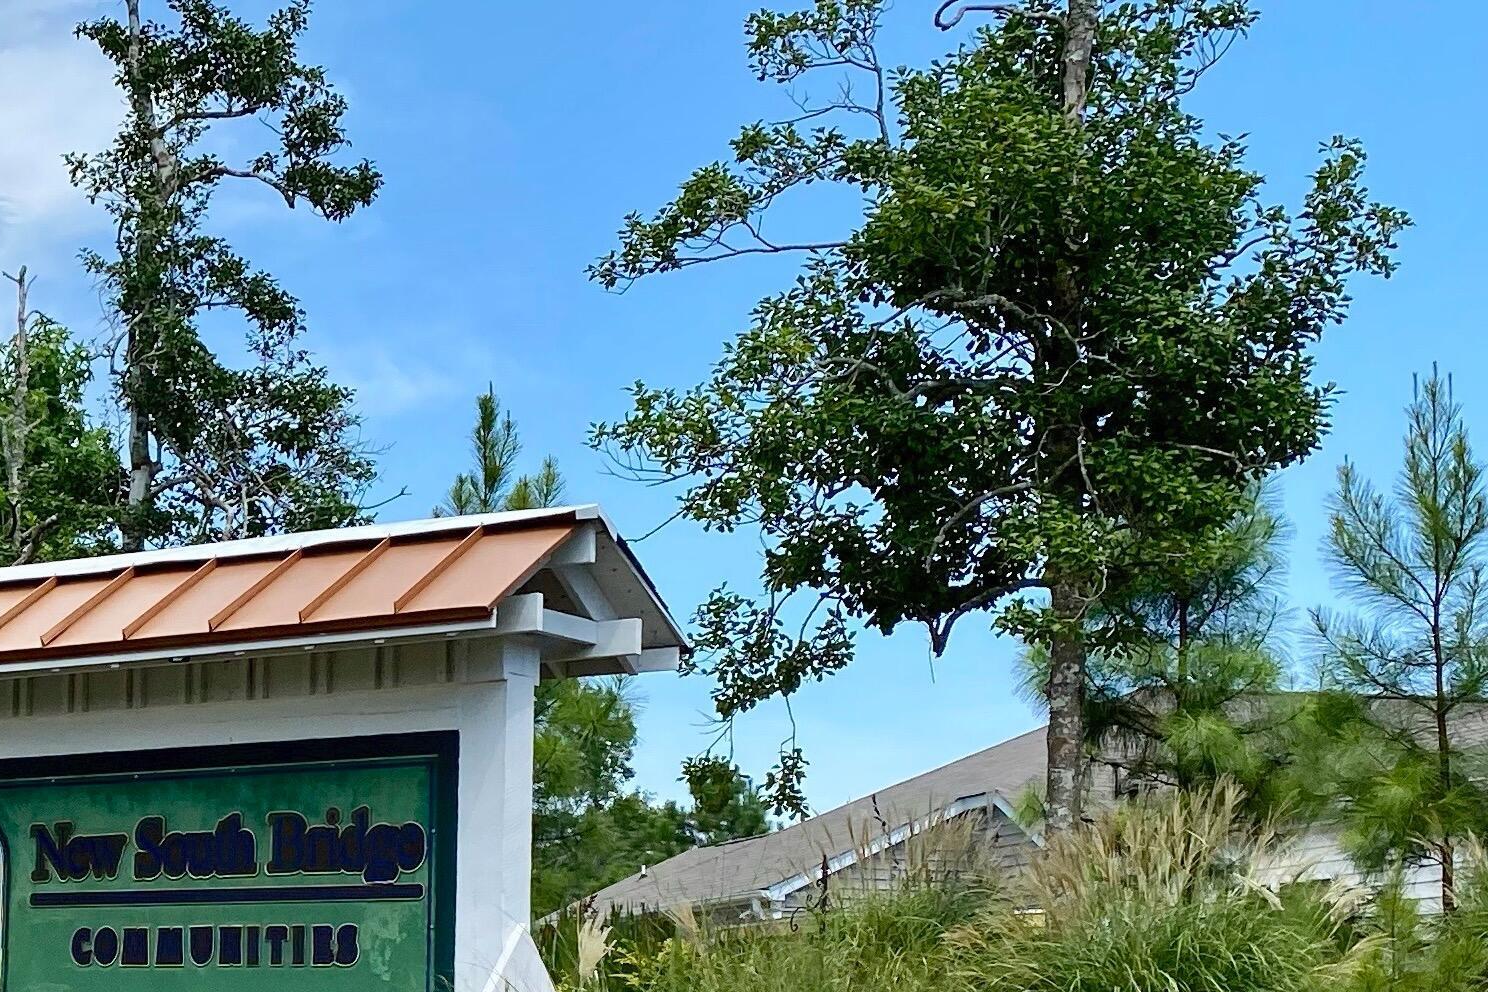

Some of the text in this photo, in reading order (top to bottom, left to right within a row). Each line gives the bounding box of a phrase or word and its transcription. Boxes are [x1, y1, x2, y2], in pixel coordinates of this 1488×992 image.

[30, 806, 427, 884] New South Bridge
[71, 923, 360, 967] COMMUNITIES
